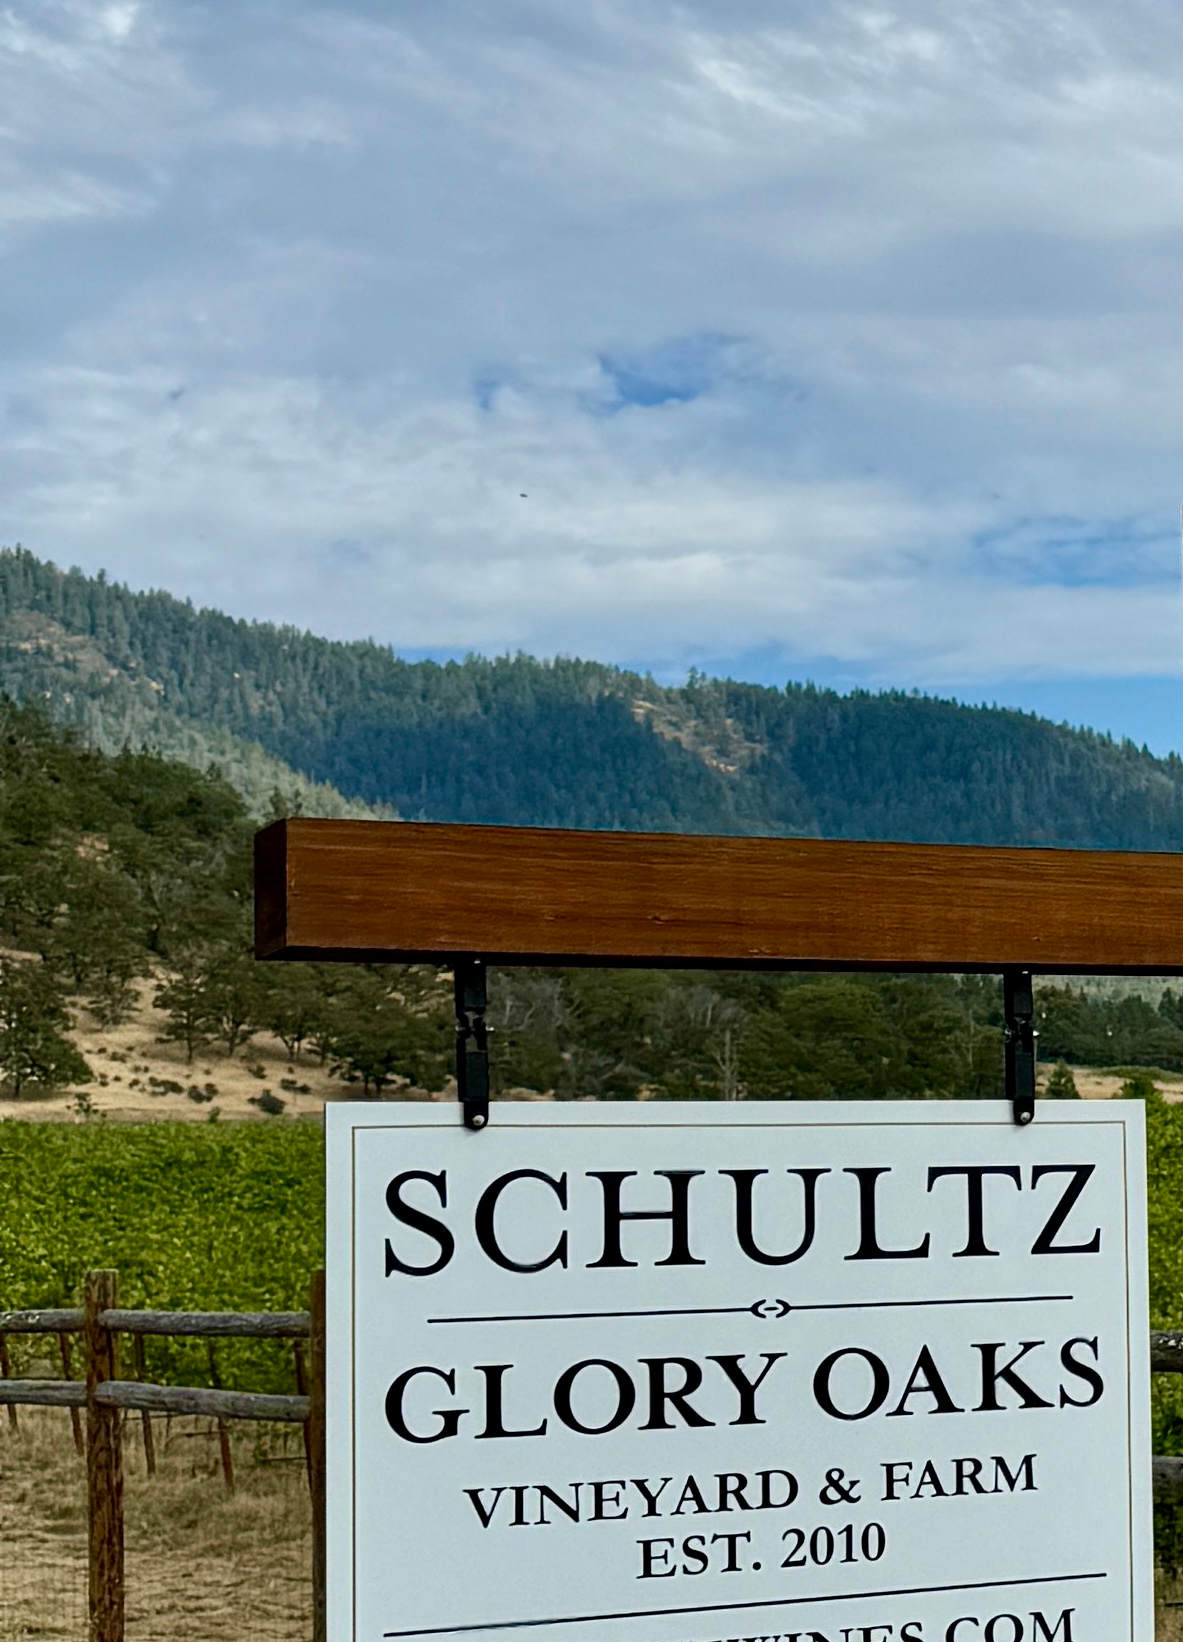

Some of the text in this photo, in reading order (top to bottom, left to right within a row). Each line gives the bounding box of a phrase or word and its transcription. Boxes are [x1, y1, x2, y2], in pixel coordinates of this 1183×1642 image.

[384, 1163, 1102, 1278] SCHULTZ
[384, 1335, 1105, 1444] GLORY OAKS
[462, 1453, 1039, 1529] VINEYARD & FARM
[635, 1522, 886, 1580] EST. 2010
